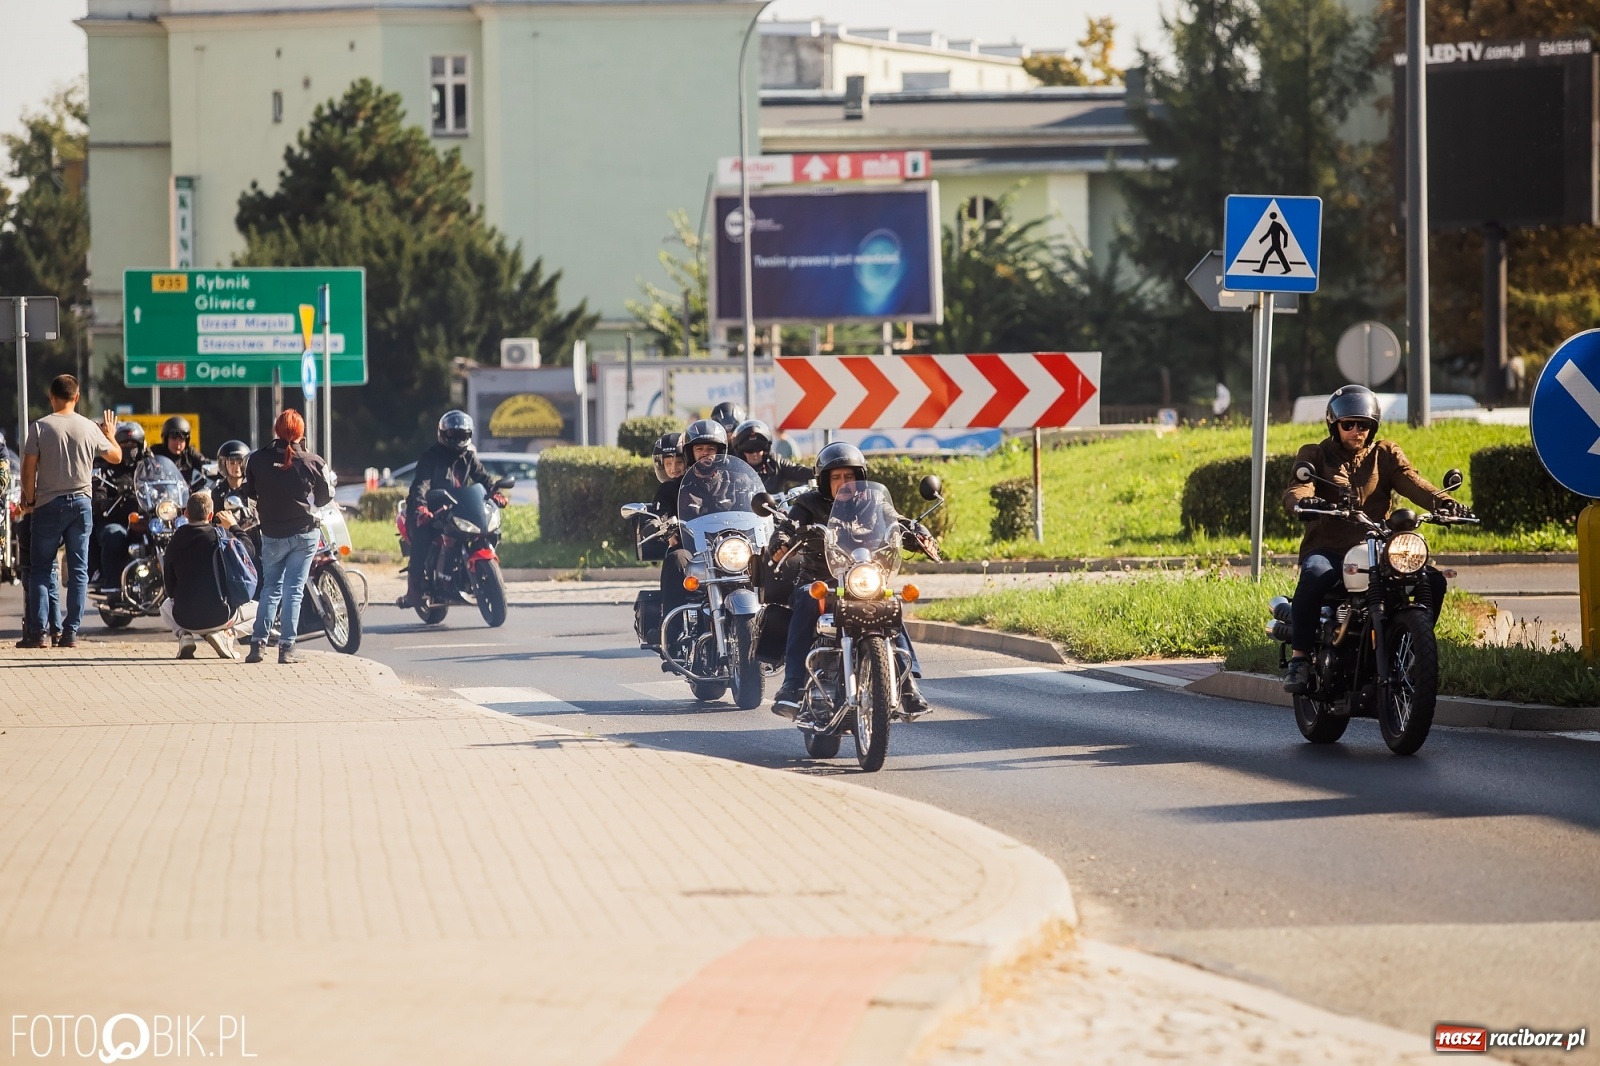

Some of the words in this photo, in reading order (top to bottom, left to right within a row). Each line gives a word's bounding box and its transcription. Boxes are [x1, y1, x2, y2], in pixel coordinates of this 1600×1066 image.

[861, 153, 900, 177] min
[158, 277, 182, 289] 935
[195, 274, 250, 291] Rybnik
[194, 295, 256, 311] Gliwice
[244, 317, 289, 332] Miejski
[202, 338, 264, 350] Starostwo
[163, 364, 180, 378] 45
[196, 362, 247, 381] Opole
